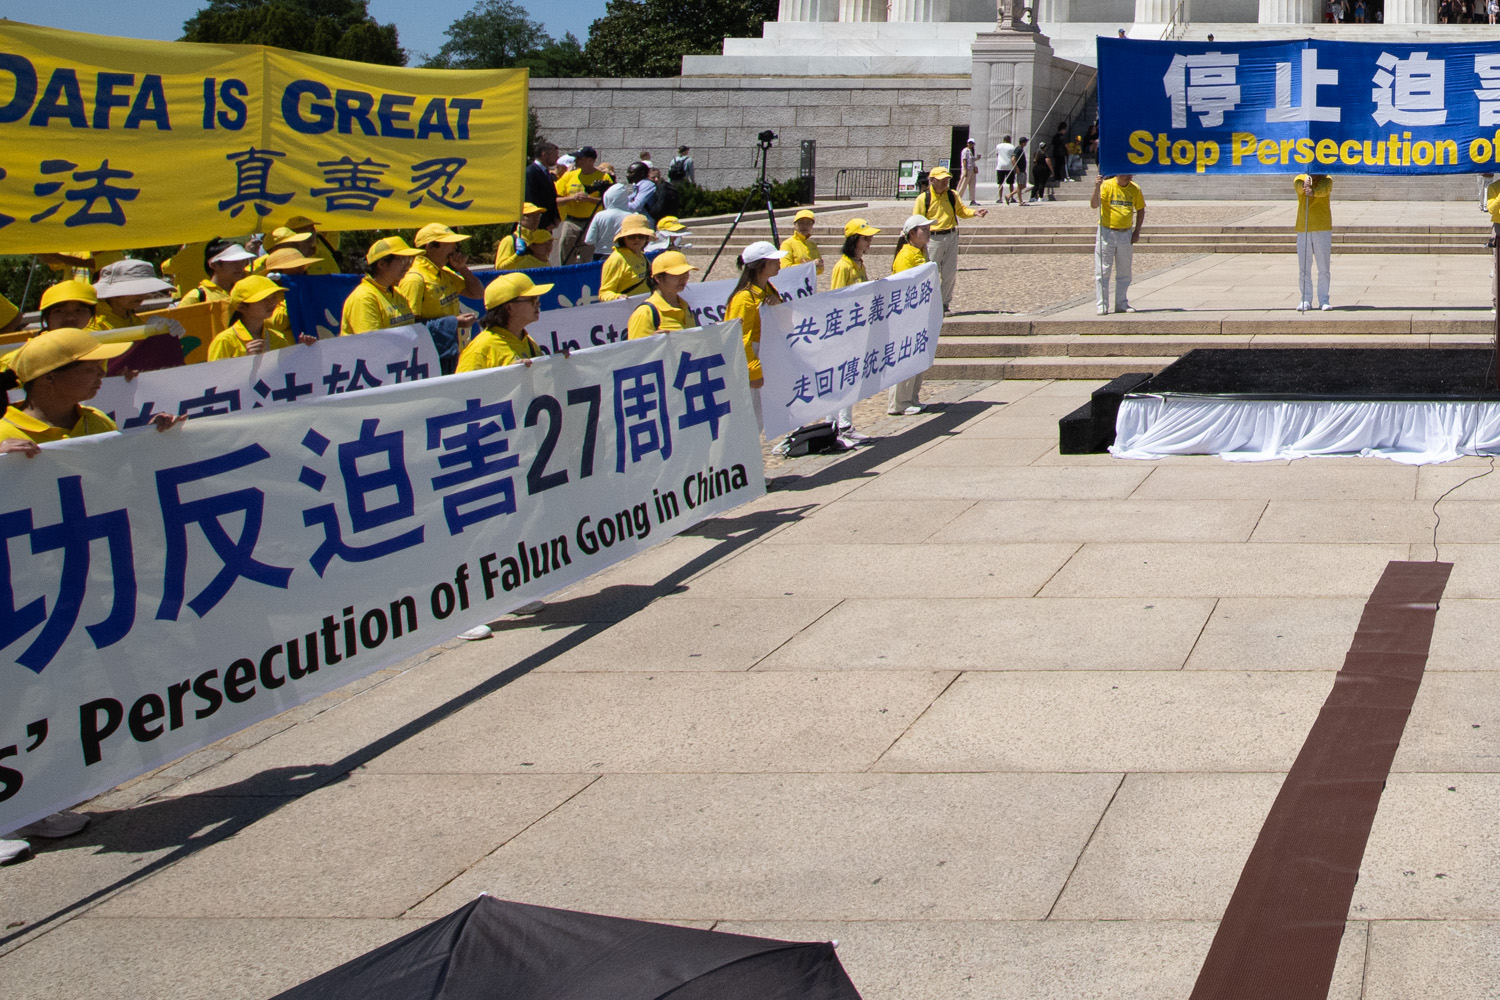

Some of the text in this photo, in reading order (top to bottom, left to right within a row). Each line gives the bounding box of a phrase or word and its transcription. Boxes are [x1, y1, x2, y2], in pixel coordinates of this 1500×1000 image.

[0, 52, 484, 141] DAFA IS GREAT
[0, 146, 474, 230] 法 真善忍
[1127, 131, 1220, 173] Stop
[1232, 132, 1458, 165] Persecution
[79, 594, 418, 767] Persecution
[430, 563, 470, 621] of
[480, 534, 573, 601] Falun
[576, 502, 651, 557] Gong
[654, 488, 680, 525] in
[683, 462, 749, 510] China
